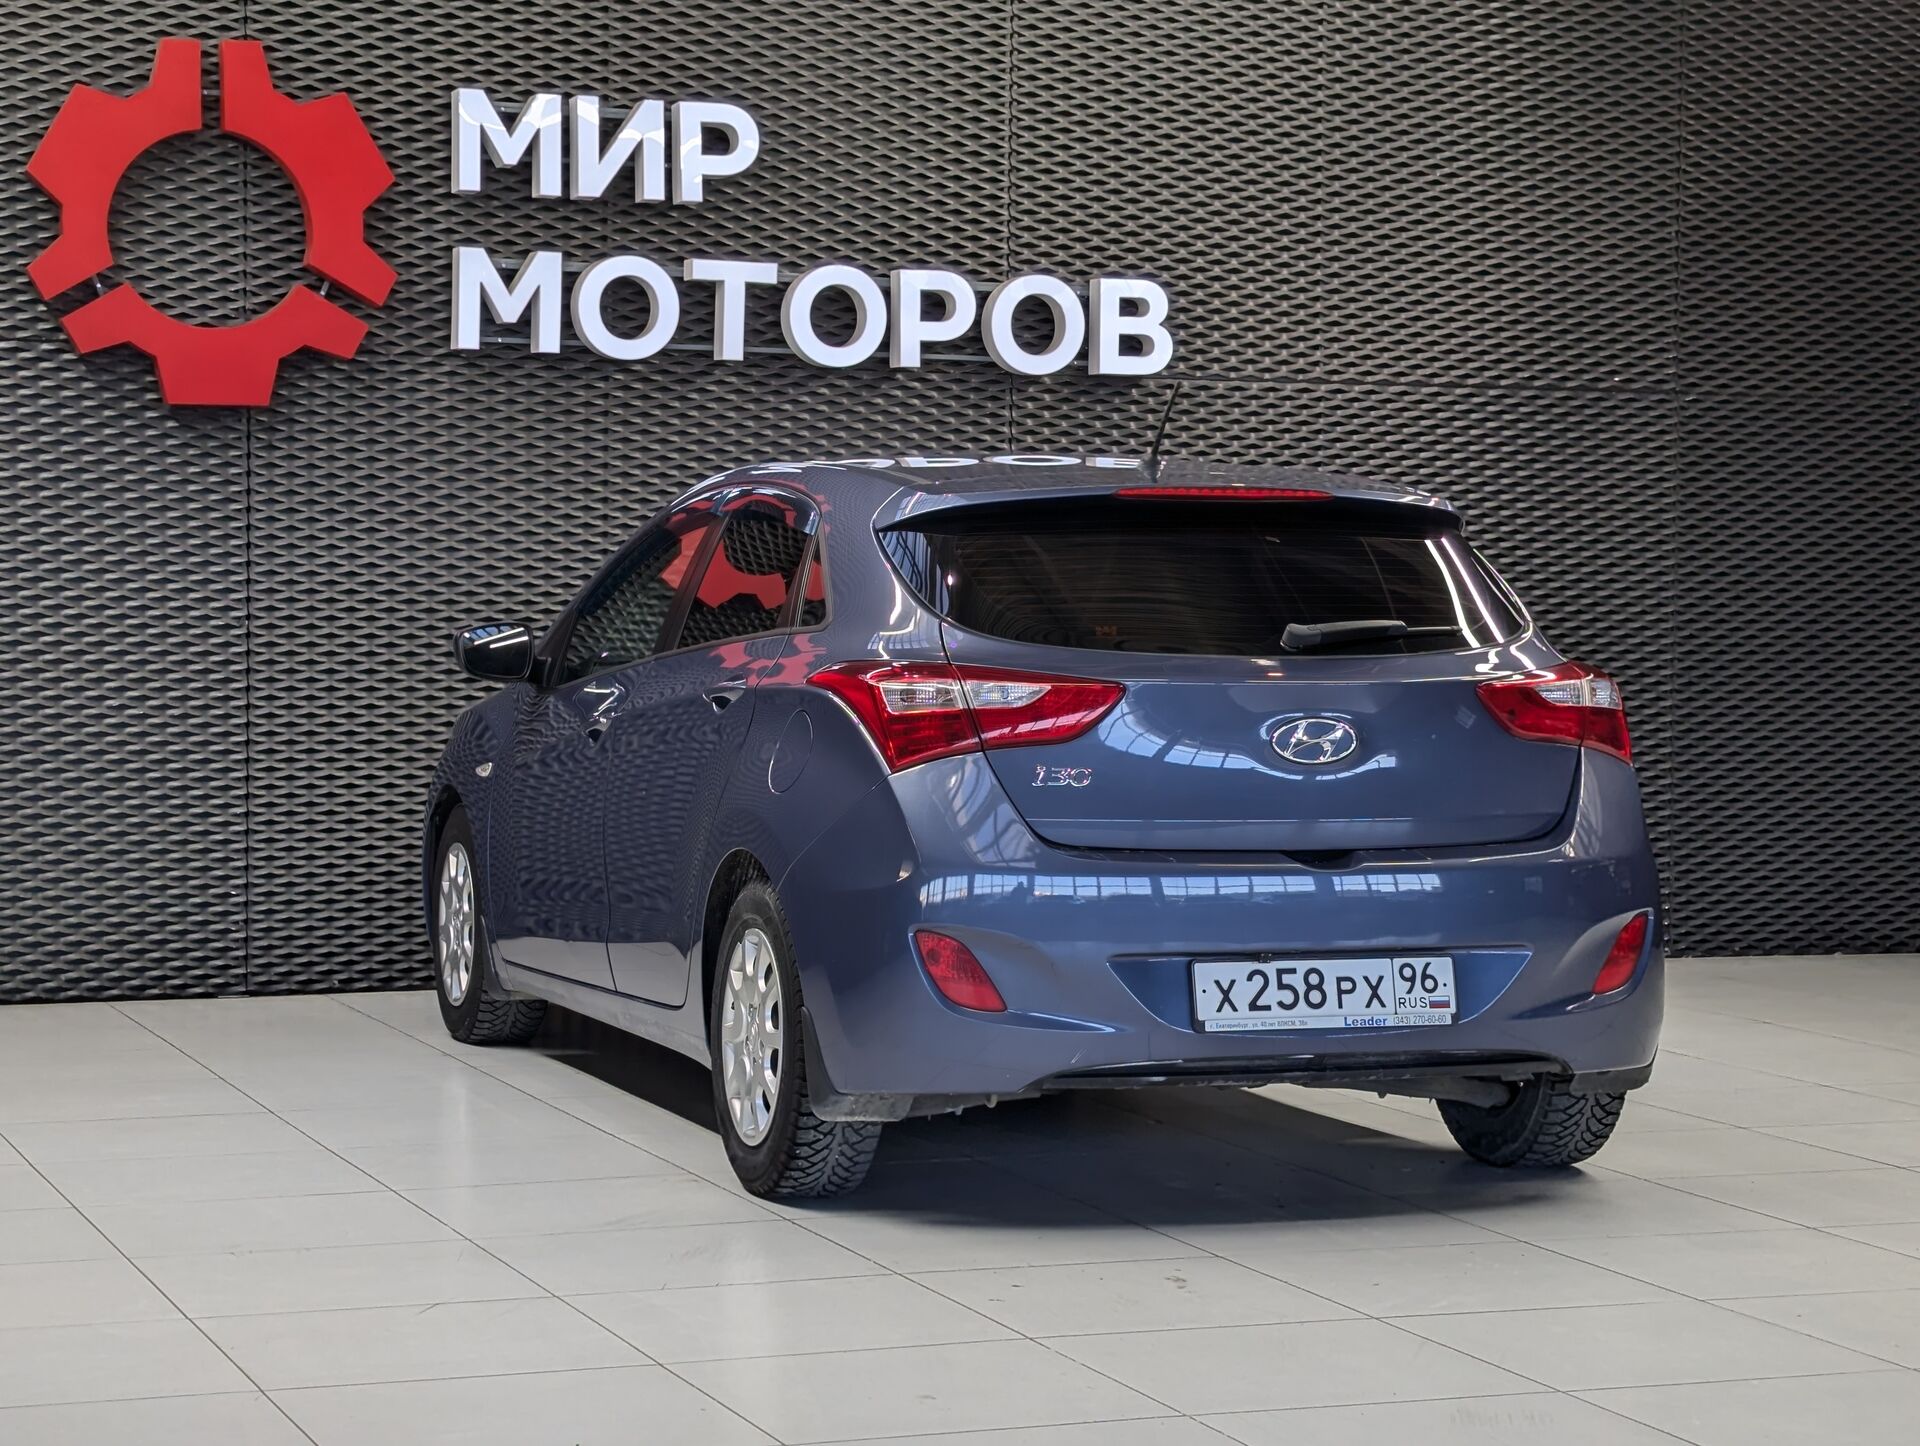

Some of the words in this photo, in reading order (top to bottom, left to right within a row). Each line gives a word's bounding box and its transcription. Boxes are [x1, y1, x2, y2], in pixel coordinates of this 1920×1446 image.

[450, 87, 761, 204] МИР
[450, 246, 1174, 375] МОТОРОВ
[1031, 764, 1092, 787] i30
[1398, 962, 1439, 994] 96
[1398, 996, 1428, 1009] RUS
[1344, 1016, 1388, 1027] Leader
[1393, 1015, 1411, 1025] (343)
[1413, 1014, 1447, 1024] 270-60-60
